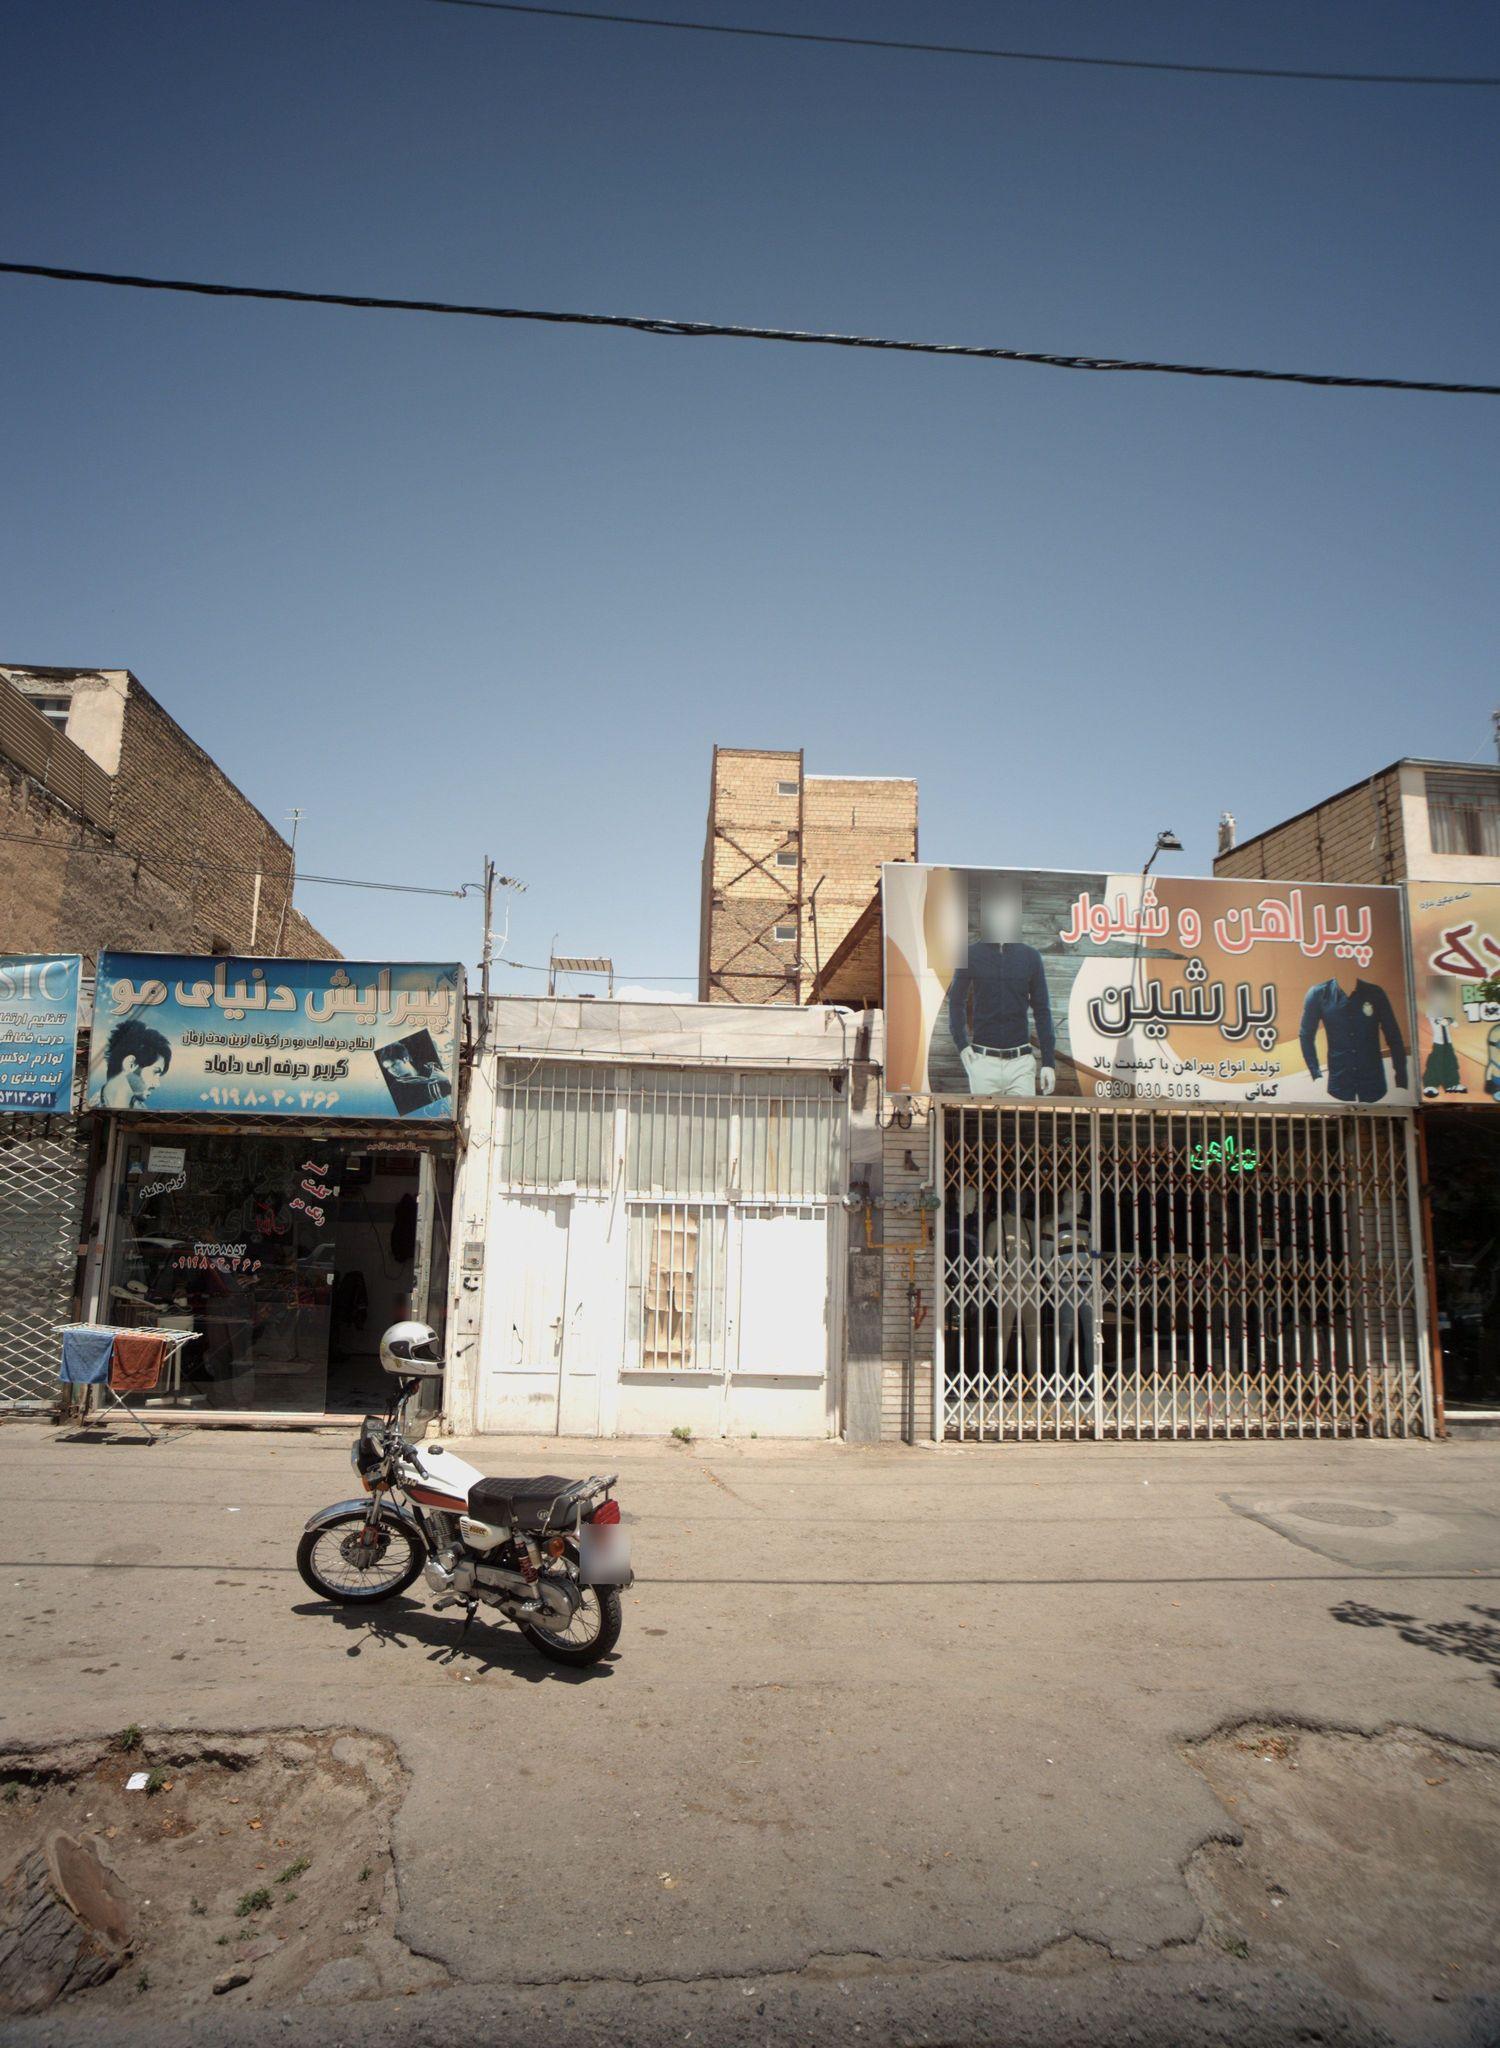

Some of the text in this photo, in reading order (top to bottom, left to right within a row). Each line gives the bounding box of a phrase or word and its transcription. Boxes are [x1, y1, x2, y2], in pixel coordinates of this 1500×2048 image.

[1059, 889, 1170, 945] شلوار
[1178, 908, 1201, 948] و
[1214, 889, 1373, 967] پیراهن
[111, 962, 449, 1034] پیرایش دنیای مو
[1461, 985, 1490, 1003] BE
[1089, 958, 1276, 1049] پرشین
[27, 1012, 66, 1029] تنظیم
[37, 1034, 64, 1046] درب
[182, 1031, 373, 1049] اصلاح حرفه ای مو در کوتاه ترین مدت زمان
[30, 1053, 64, 1068] لوازم
[205, 1055, 241, 1072] داماد
[246, 1056, 270, 1073] ای
[274, 1059, 308, 1079] حرفه
[1093, 1056, 1280, 1077] تولید انواع پیراهن با کیفیت بالا
[11, 1072, 38, 1085] بنزی
[40, 1070, 63, 1086] آینه
[1096, 1081, 1200, 1098] 0930 030 5058
[139, 1182, 165, 1200] داماد
[289, 1197, 305, 1210] مو
